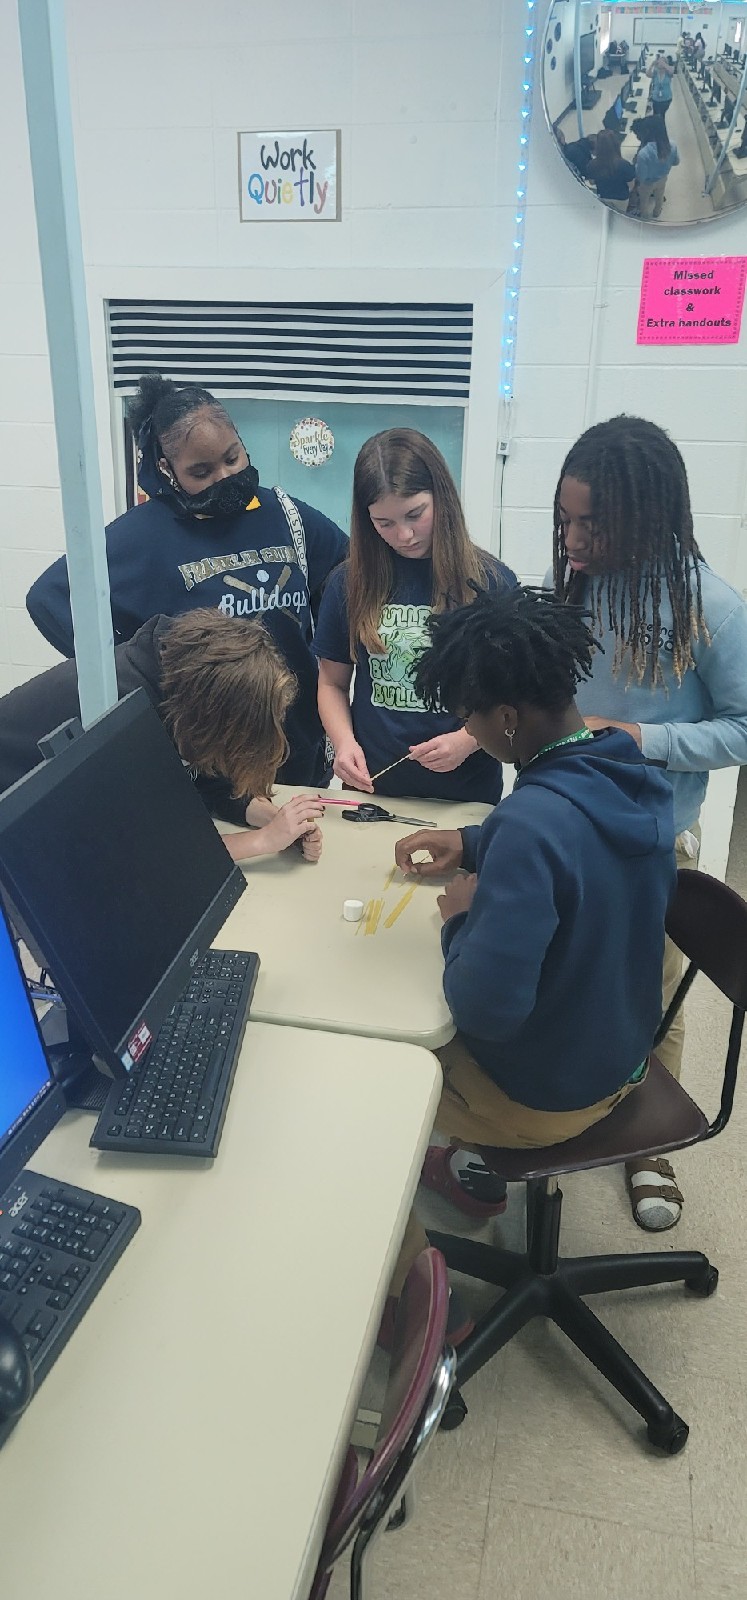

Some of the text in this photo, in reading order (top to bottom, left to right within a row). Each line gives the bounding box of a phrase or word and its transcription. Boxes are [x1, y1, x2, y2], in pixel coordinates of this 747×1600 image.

[260, 138, 316, 172] Work
[247, 166, 328, 214] Quietly
[673, 270, 714, 280] Missed
[664, 286, 721, 296] classwork
[685, 303, 695, 312] &
[646, 318, 731, 327] Extra handouts
[294, 428, 329, 449] Sparkle
[218, 584, 307, 618] Bulldogs
[8, 1192, 29, 1217] acer
